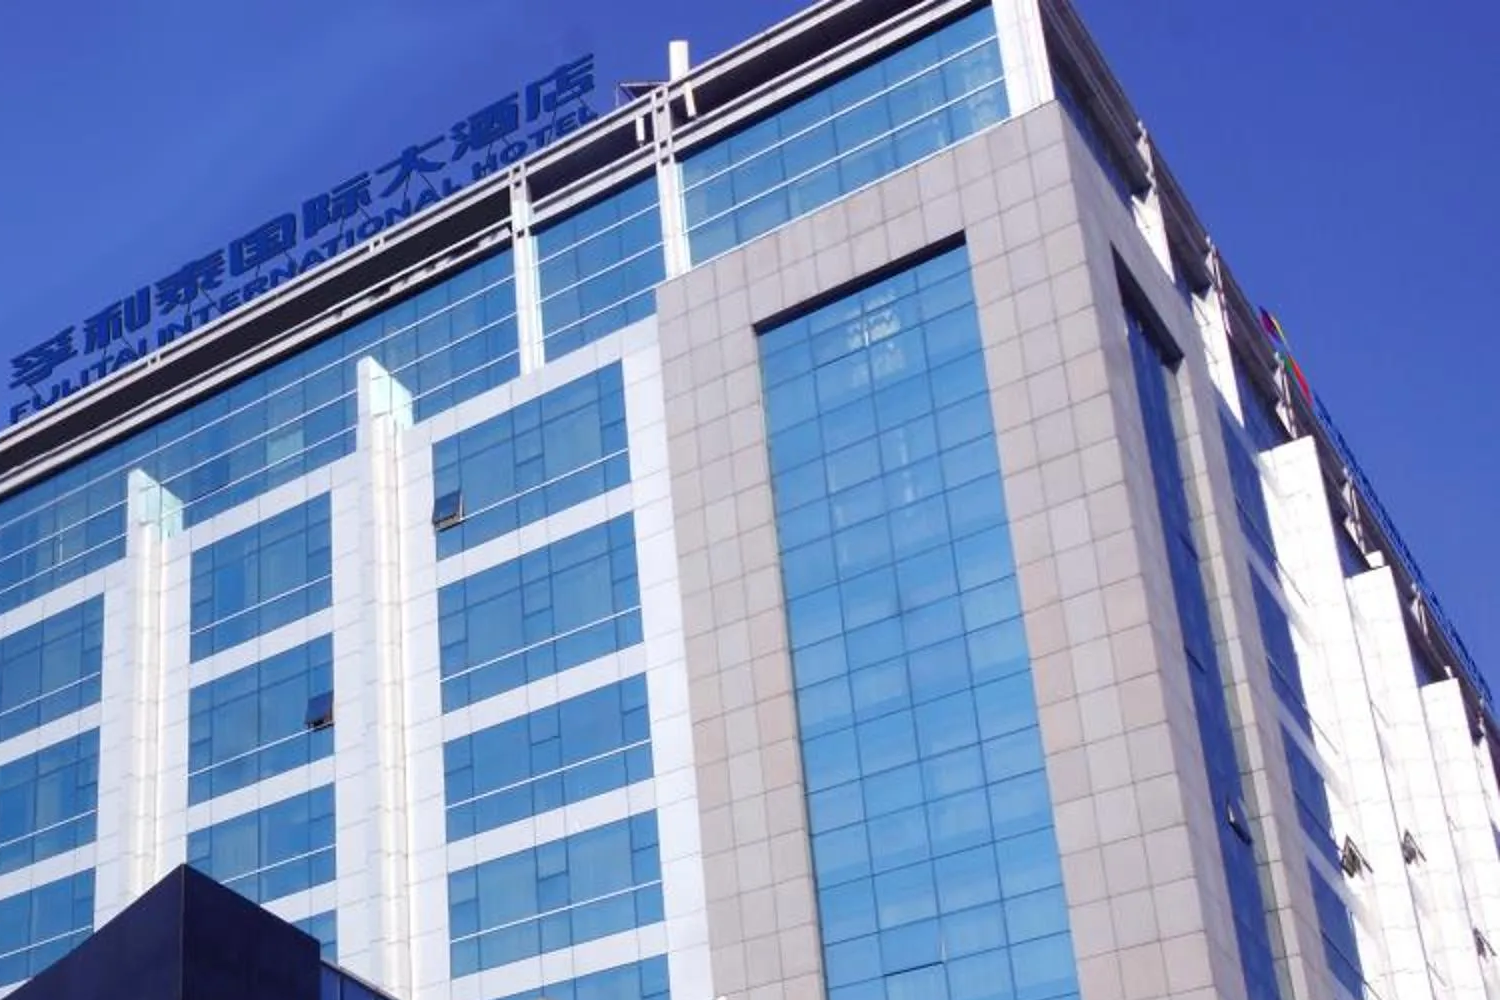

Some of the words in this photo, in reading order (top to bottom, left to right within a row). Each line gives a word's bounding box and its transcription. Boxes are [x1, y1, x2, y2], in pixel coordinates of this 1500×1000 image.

[9, 337, 148, 424] FULITAI
[157, 178, 462, 349] INTERNATIONAL
[472, 104, 598, 182] HOTEL
